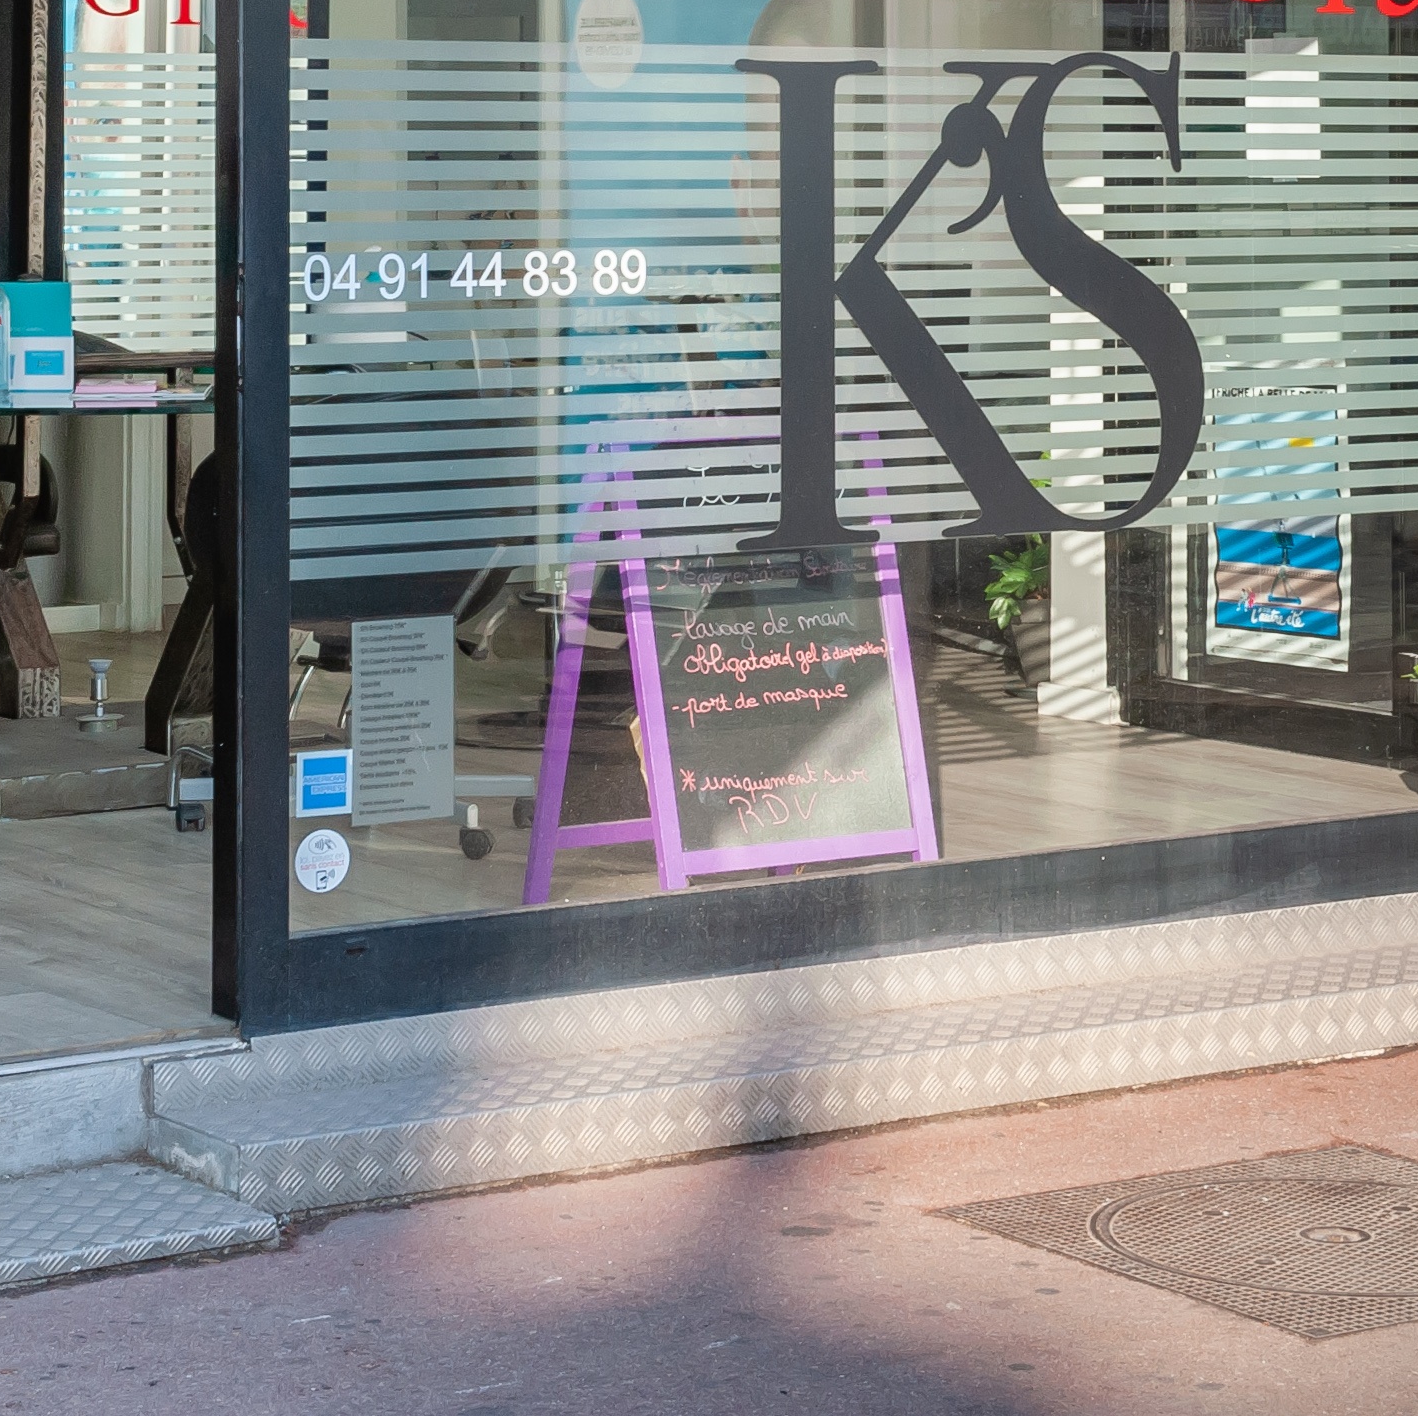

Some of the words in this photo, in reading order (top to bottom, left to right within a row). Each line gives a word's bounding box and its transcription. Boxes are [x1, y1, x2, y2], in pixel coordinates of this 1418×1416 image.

[303, 252, 362, 301] 04
[378, 251, 429, 300] 91
[450, 250, 507, 299] 44
[522, 249, 578, 298] 83
[592, 247, 648, 297] 89
[762, 607, 794, 636] de
[797, 606, 855, 633] main
[822, 646, 831, 662] à
[734, 691, 760, 710] de
[763, 683, 849, 712] masque
[822, 767, 870, 784] sur
[728, 792, 818, 835] RDV
